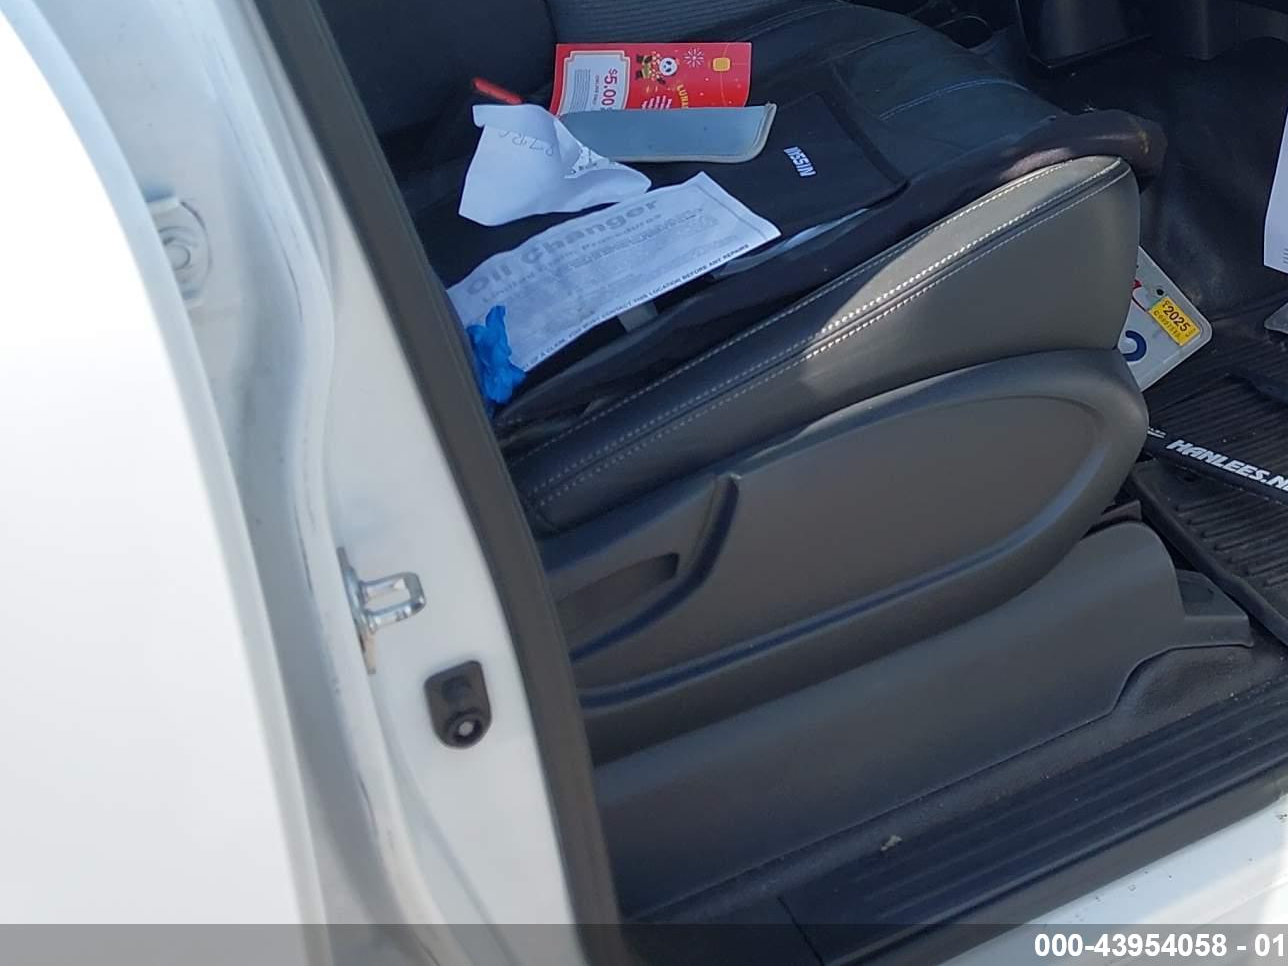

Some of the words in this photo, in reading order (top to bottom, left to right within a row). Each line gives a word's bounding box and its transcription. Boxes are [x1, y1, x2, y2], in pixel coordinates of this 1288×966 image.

[600, 68, 619, 106] $5.00
[465, 259, 512, 296] Oil
[1163, 304, 1191, 332] 2025
